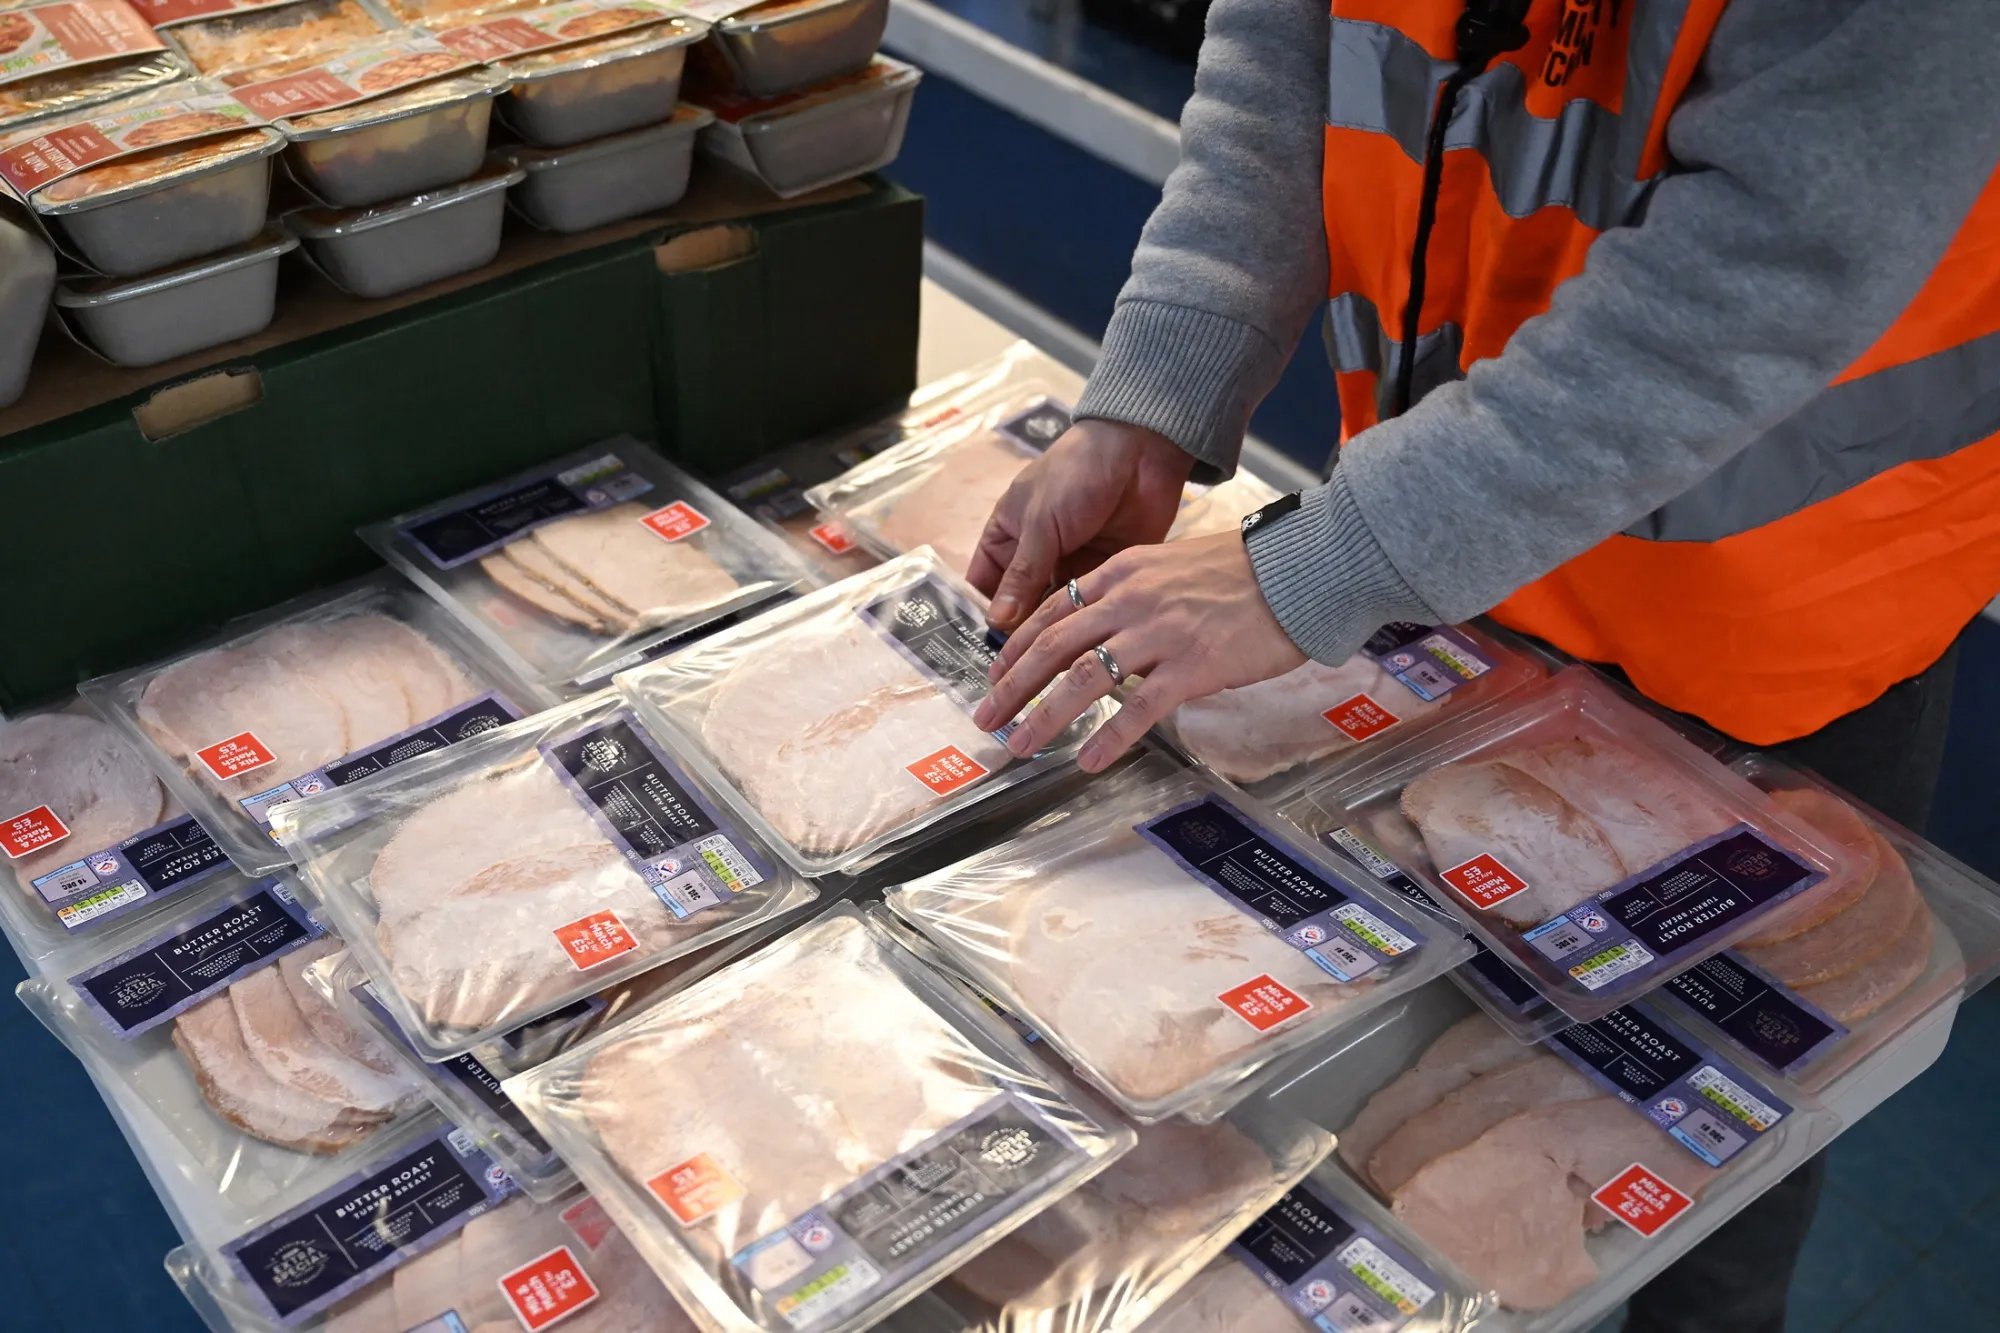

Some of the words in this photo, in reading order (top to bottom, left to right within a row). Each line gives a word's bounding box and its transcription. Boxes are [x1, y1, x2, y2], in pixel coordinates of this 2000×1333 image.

[896, 600, 928, 627] SPECIAL
[904, 599, 933, 622] EXTRA
[954, 634, 982, 656] TURKEY
[956, 624, 990, 652] BUTTER
[1350, 705, 1380, 725] Match
[1358, 701, 1379, 715] Mix
[455, 716, 501, 740] SPECIAL
[1339, 716, 1360, 730] £5
[216, 741, 240, 754] £5
[219, 749, 257, 767] Match
[583, 740, 616, 772] SPECIAL
[593, 739, 621, 765] EXTRA
[226, 763, 240, 771] &
[237, 754, 260, 767] Mix
[935, 757, 967, 778] Match
[944, 753, 967, 767] Mix
[960, 763, 975, 773] &
[922, 769, 945, 784] £5
[639, 782, 665, 806] TURKEY
[659, 805, 684, 828] BREAST
[644, 772, 677, 804] BUTTER
[670, 802, 701, 830] ROAST
[8, 829, 23, 837] for
[9, 816, 34, 830] £5
[11, 824, 51, 844] Match
[26, 820, 44, 829] Any
[18, 840, 32, 849] &
[29, 830, 54, 844] Mix
[123, 835, 139, 846] 100g
[158, 857, 202, 880] ROAST
[163, 851, 199, 869] BREAST
[1459, 864, 1484, 879] £5
[1726, 849, 1770, 874] SPECIAL
[1737, 857, 1773, 877] EXTRA
[59, 879, 77, 891] DEC
[1250, 857, 1283, 879] TURKEY
[1279, 877, 1311, 898] BREAST
[1252, 848, 1294, 876] BUTTER
[1289, 874, 1329, 900] ROAST
[1464, 878, 1478, 886] for
[1470, 875, 1506, 894] Match
[1478, 869, 1495, 879] Any
[685, 888, 702, 901] DEC
[1480, 891, 1493, 900] &
[1488, 882, 1512, 896] Mix
[1685, 895, 1719, 915] TURKEY
[1690, 897, 1737, 925] BUTTER
[171, 926, 222, 956] BUTTER
[221, 904, 265, 930] ROAST
[598, 919, 620, 937] Mix
[611, 934, 625, 944] &
[1654, 910, 1689, 931] BREAST
[1655, 920, 1695, 944] ROAST
[187, 934, 226, 957] TURKEY
[224, 916, 261, 937] BREAST
[568, 936, 591, 954] £5
[586, 921, 616, 950] Match
[1553, 938, 1571, 950] DEC
[1340, 951, 1357, 963] DEC
[115, 974, 156, 999] EXTRA
[115, 976, 166, 1006] SPECIAL
[1261, 983, 1286, 999] Mix
[1279, 995, 1295, 1005] &
[1668, 975, 1719, 1011] BUTTER
[1680, 973, 1717, 999] TURKEY
[1236, 1000, 1263, 1017] £5
[1249, 986, 1289, 1012] Match
[1598, 1014, 1631, 1037] URKEY
[1627, 1035, 1665, 1061] BREAST
[1608, 1009, 1643, 1033] TTER
[1637, 1031, 1682, 1062] ROAST
[1751, 1016, 1792, 1045] EXTRA
[1753, 1009, 1802, 1044] SPECIAL
[467, 1062, 503, 1095] BUTTER
[978, 1127, 1032, 1162] SPECIAL
[990, 1137, 1035, 1166] EXTRA
[334, 1182, 391, 1218] BUTTER
[389, 1155, 438, 1186] ROAST
[393, 1169, 434, 1197] BREAST
[1636, 1175, 1664, 1195] Mix
[1659, 1191, 1674, 1203] &
[1625, 1180, 1668, 1211] Match
[930, 1190, 987, 1228] BUTTER
[1279, 1205, 1315, 1236] BREAST
[1290, 1199, 1334, 1236] ROAST
[1616, 1198, 1644, 1219] £5
[885, 1222, 936, 1257] ROAST
[271, 1248, 328, 1285] SPECIAL
[272, 1244, 317, 1274] EXTRA
[553, 1266, 578, 1290] £5
[519, 1291, 545, 1316] Mix
[526, 1273, 557, 1311] Match
